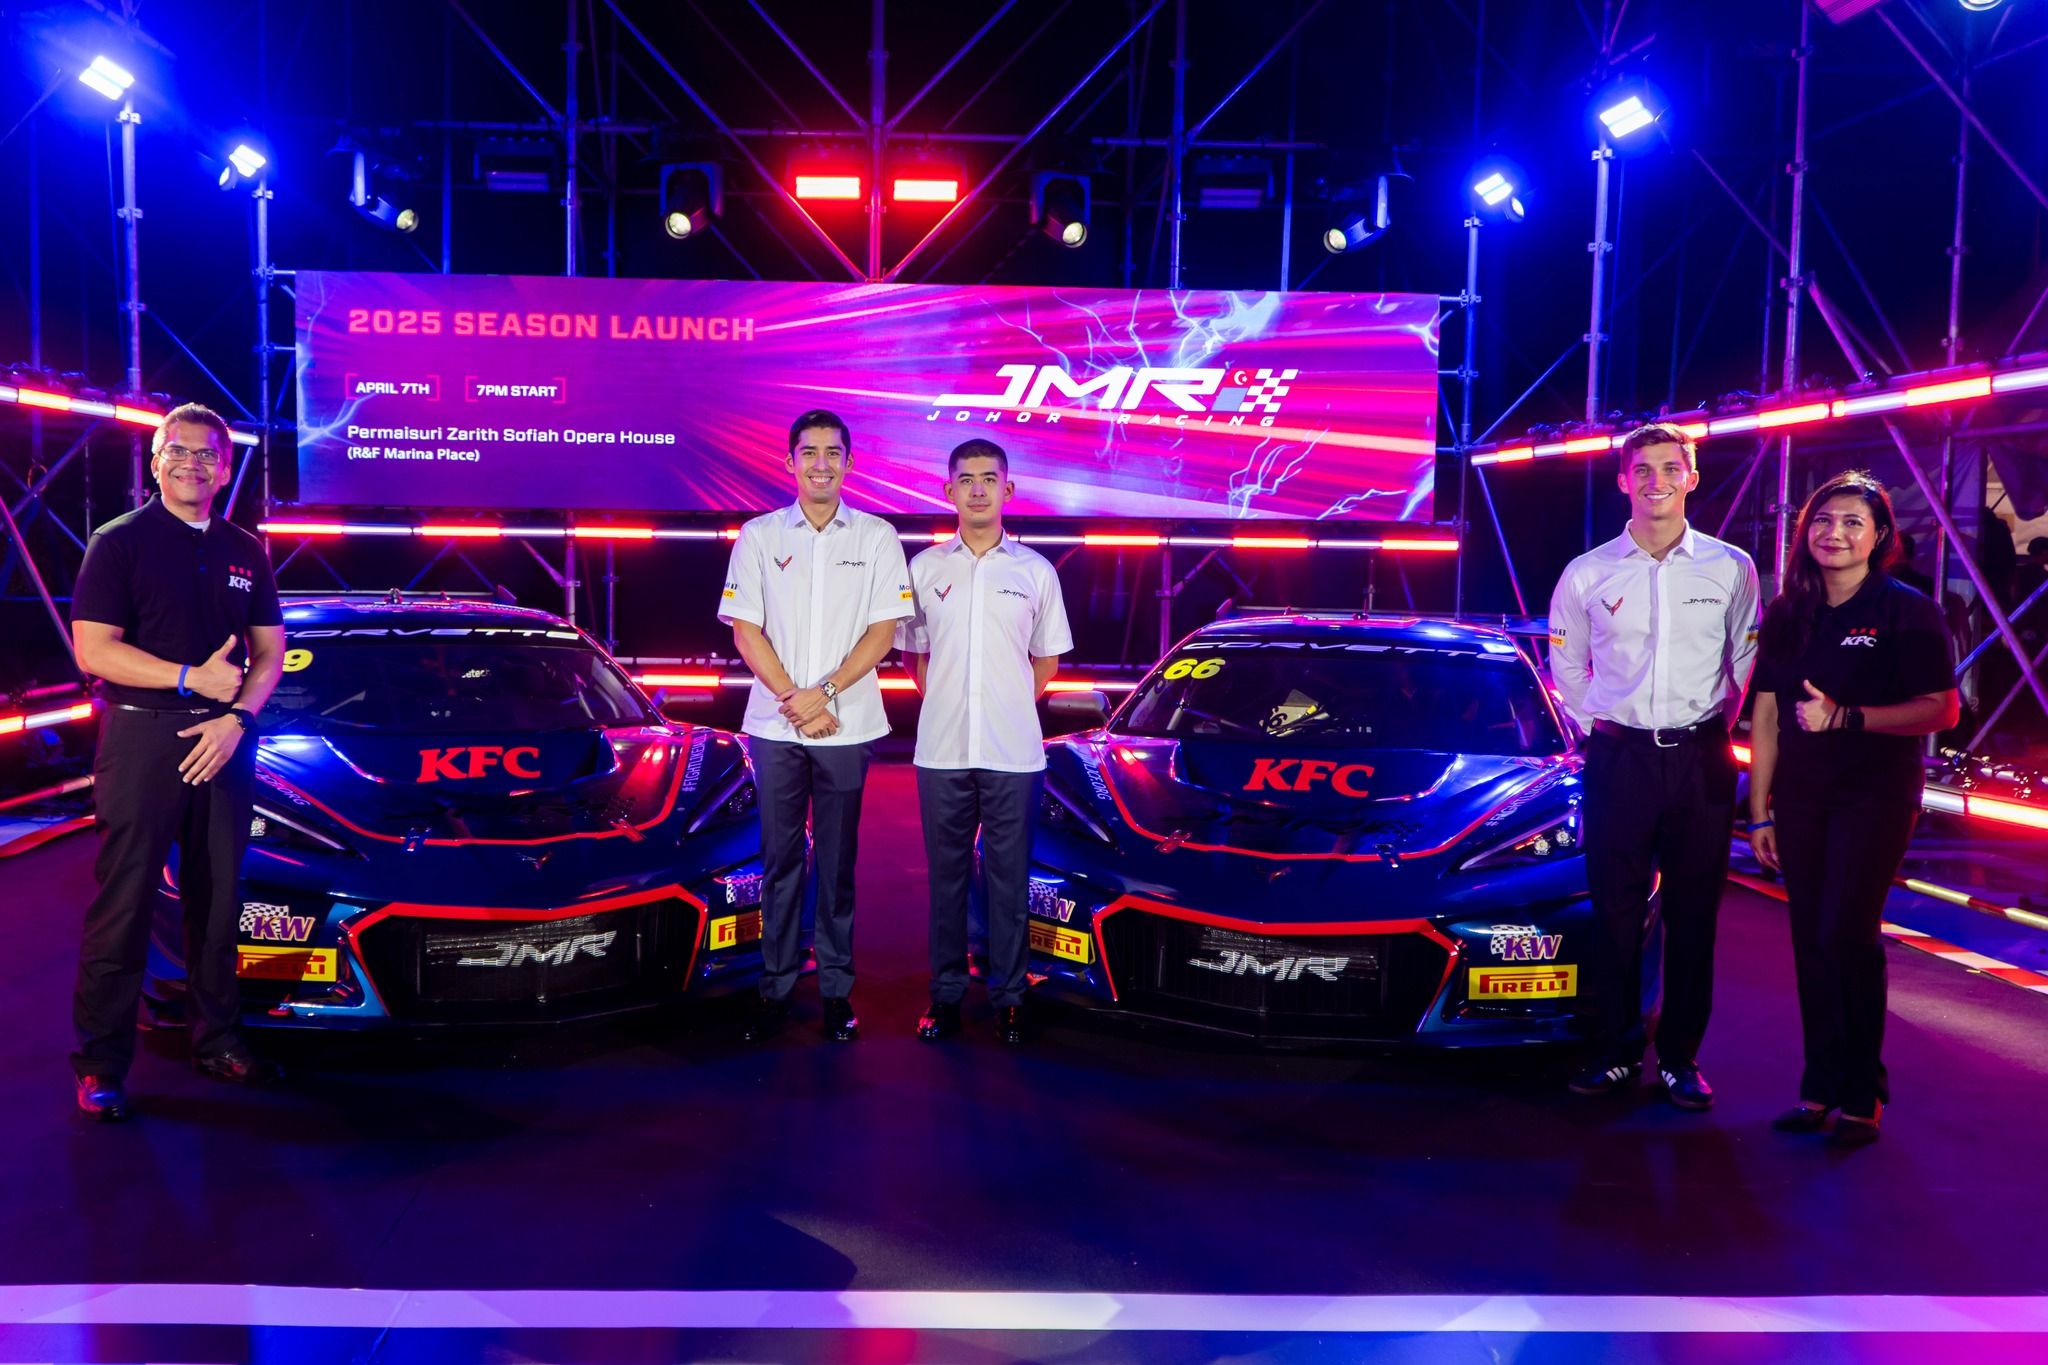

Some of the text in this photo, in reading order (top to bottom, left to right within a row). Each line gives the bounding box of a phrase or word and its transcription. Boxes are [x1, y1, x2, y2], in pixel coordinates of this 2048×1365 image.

[348, 309, 756, 341] 2025 SEASON LAUNCH
[355, 382, 430, 395] APRIL 7TH
[476, 384, 557, 398] 7PM START
[931, 363, 1226, 412] JMR
[926, 411, 1276, 427] JOHOR RACING
[347, 425, 676, 446] Permaisuri Zarith Sofiah Opera House
[347, 446, 480, 462] (R&F Marina Place)
[228, 575, 252, 592] KFC
[284, 628, 580, 641] ORVETTE
[1840, 635, 1877, 648] KFC
[1182, 642, 1518, 664] CORVETTE
[1163, 658, 1226, 681] 66
[416, 746, 541, 783] KFC
[1242, 758, 1376, 798] KFC
[1029, 892, 1077, 923] KW
[250, 915, 316, 942] KW
[456, 930, 618, 967] JMR
[1029, 925, 1082, 956] RELLI
[1501, 934, 1564, 961] KW
[1187, 950, 1350, 982] JMR
[1479, 971, 1570, 994] PIRELLI
